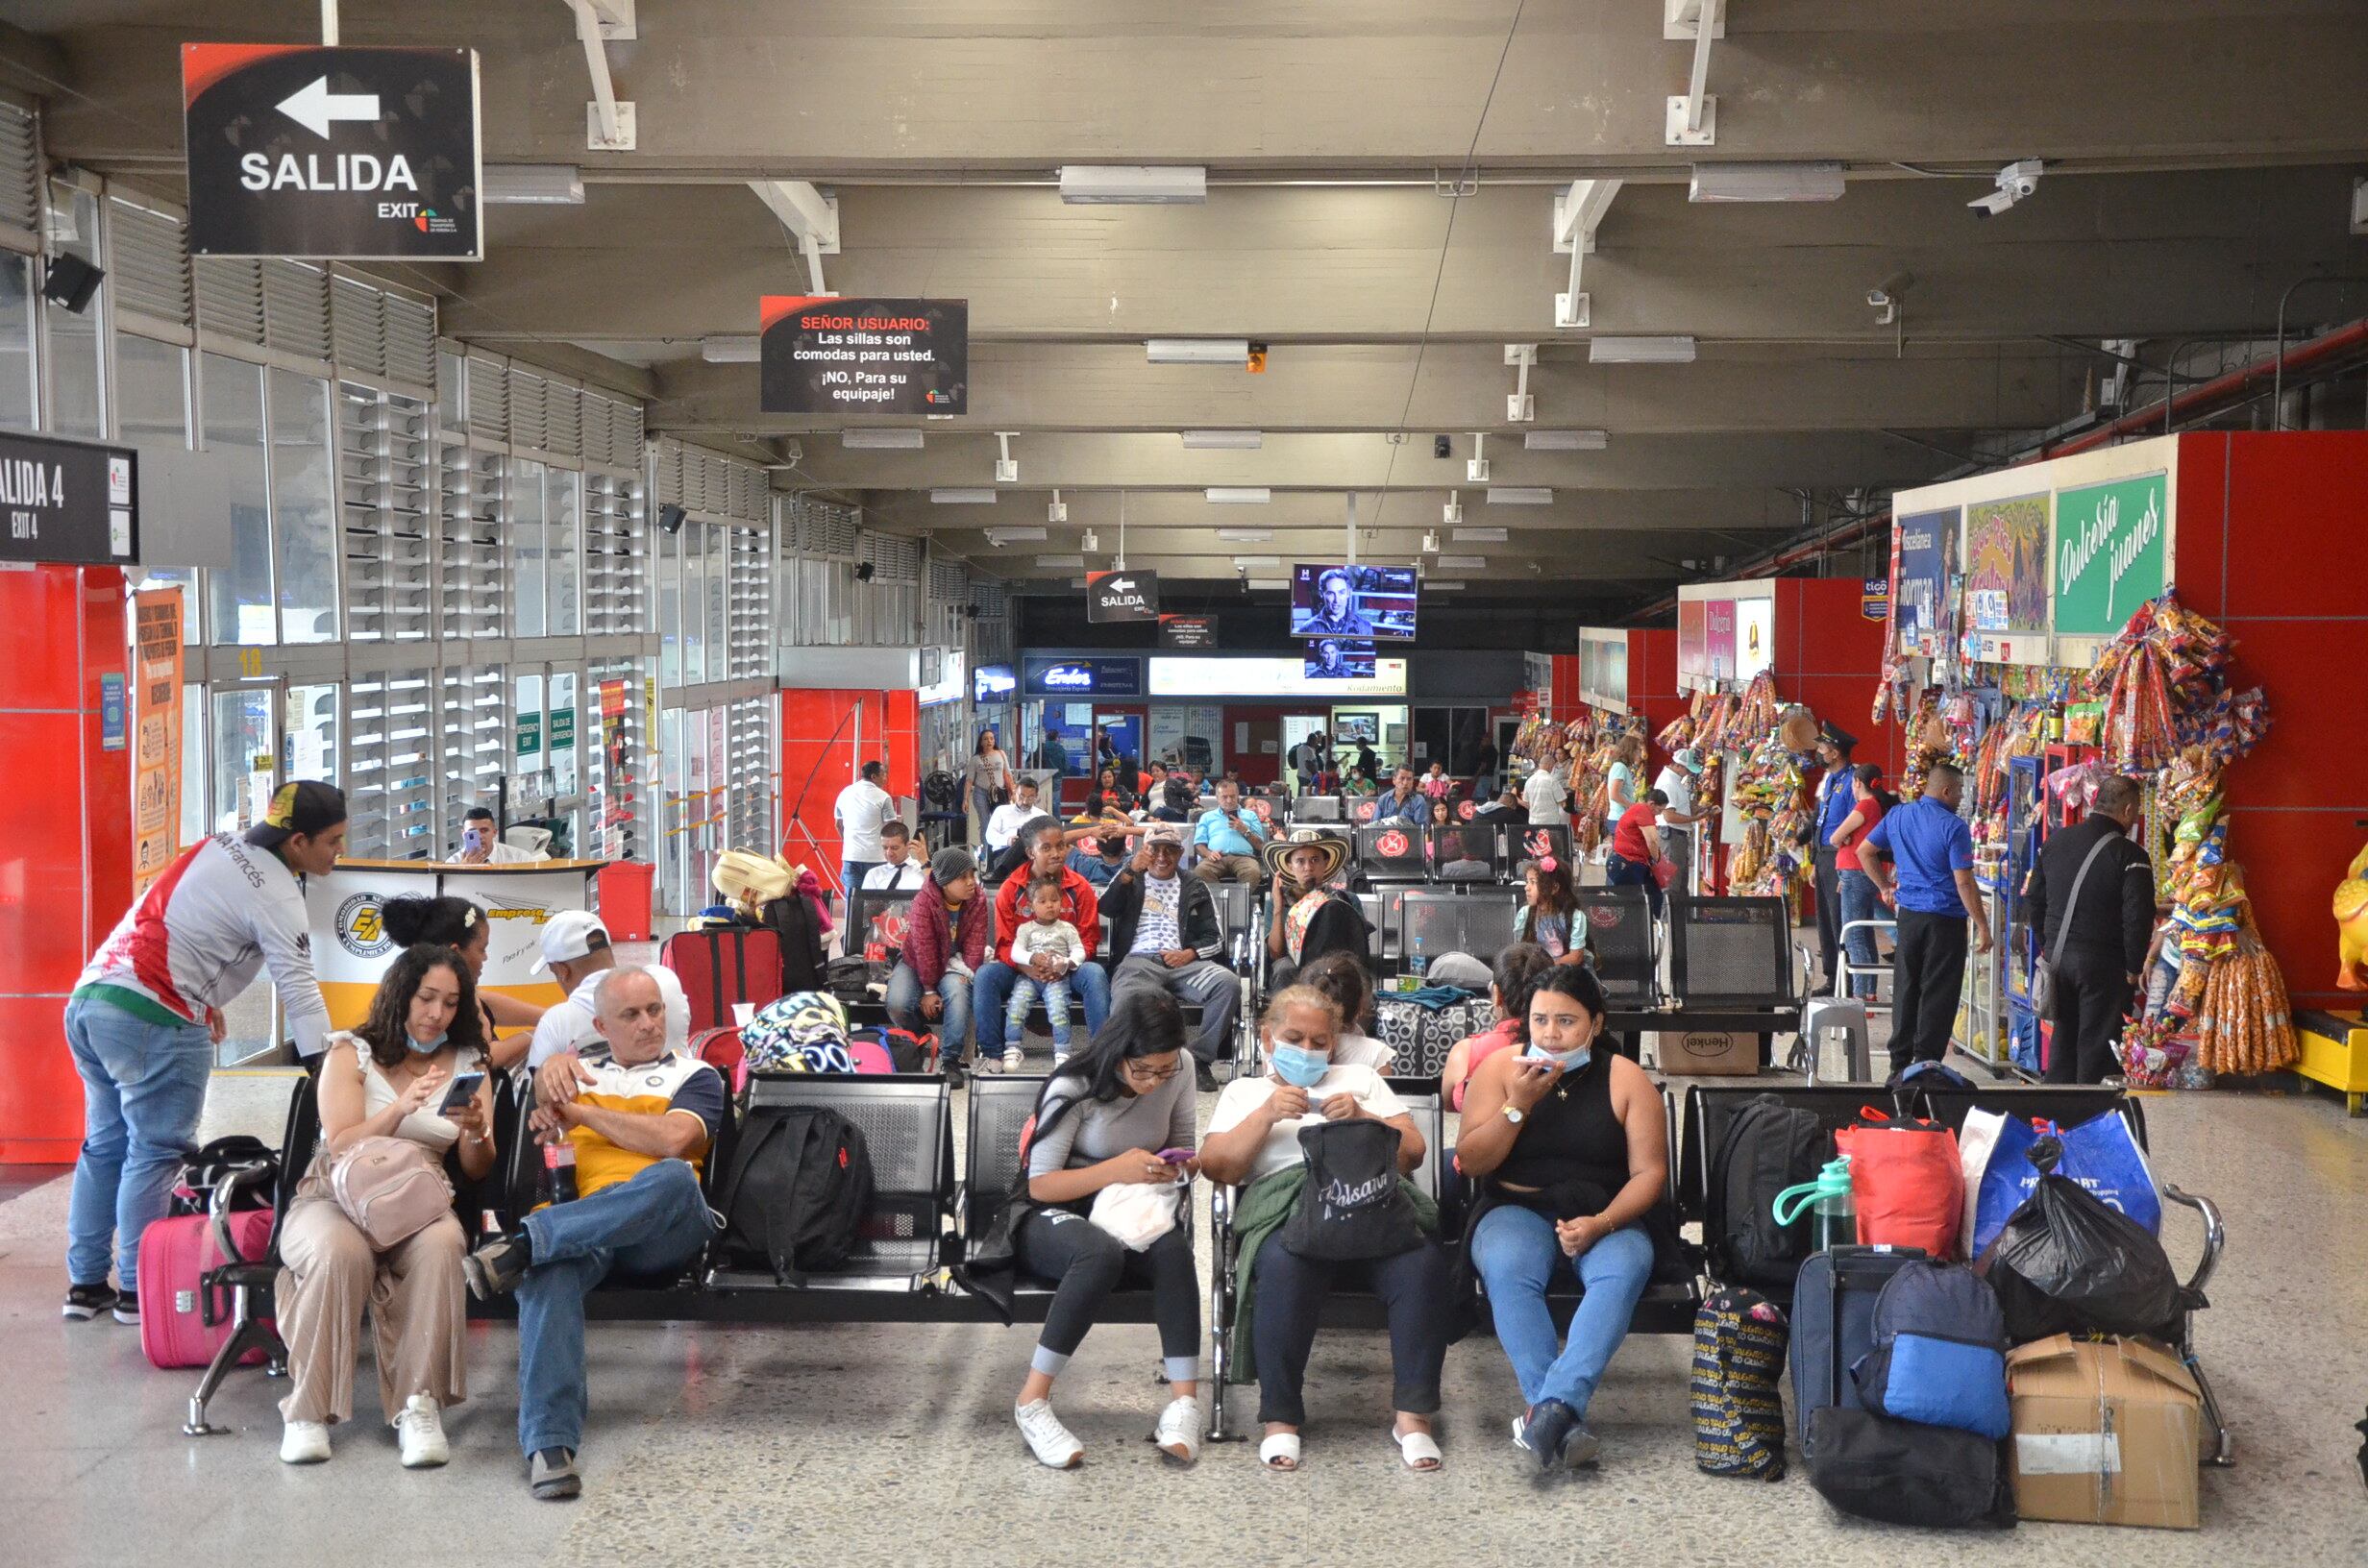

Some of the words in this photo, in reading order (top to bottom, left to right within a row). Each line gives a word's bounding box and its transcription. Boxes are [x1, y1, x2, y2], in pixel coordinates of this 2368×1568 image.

[240, 152, 418, 191] SALIDA
[378, 203, 419, 218] EXIT
[801, 314, 854, 331] SEÑOR
[857, 317, 930, 331] USUARIO:
[818, 332, 843, 345] Las
[847, 332, 882, 345] sillas
[885, 335, 911, 345] son
[794, 349, 856, 360] comodas
[860, 352, 890, 363] para
[894, 350, 936, 362] usted.
[822, 372, 851, 385] ¡NO,
[855, 372, 886, 384] Para
[890, 374, 907, 384] su
[833, 388, 895, 403] equipaje!
[51, 465, 64, 508] 4
[12, 511, 30, 539] EXIT
[31, 513, 38, 540] 4
[2106, 487, 2160, 623] juanes
[1100, 595, 1146, 607] SALIDA
[517, 723, 539, 734] MERGENCY
[486, 908, 546, 920] Empresa
[1687, 1038, 1729, 1048] Henkel
